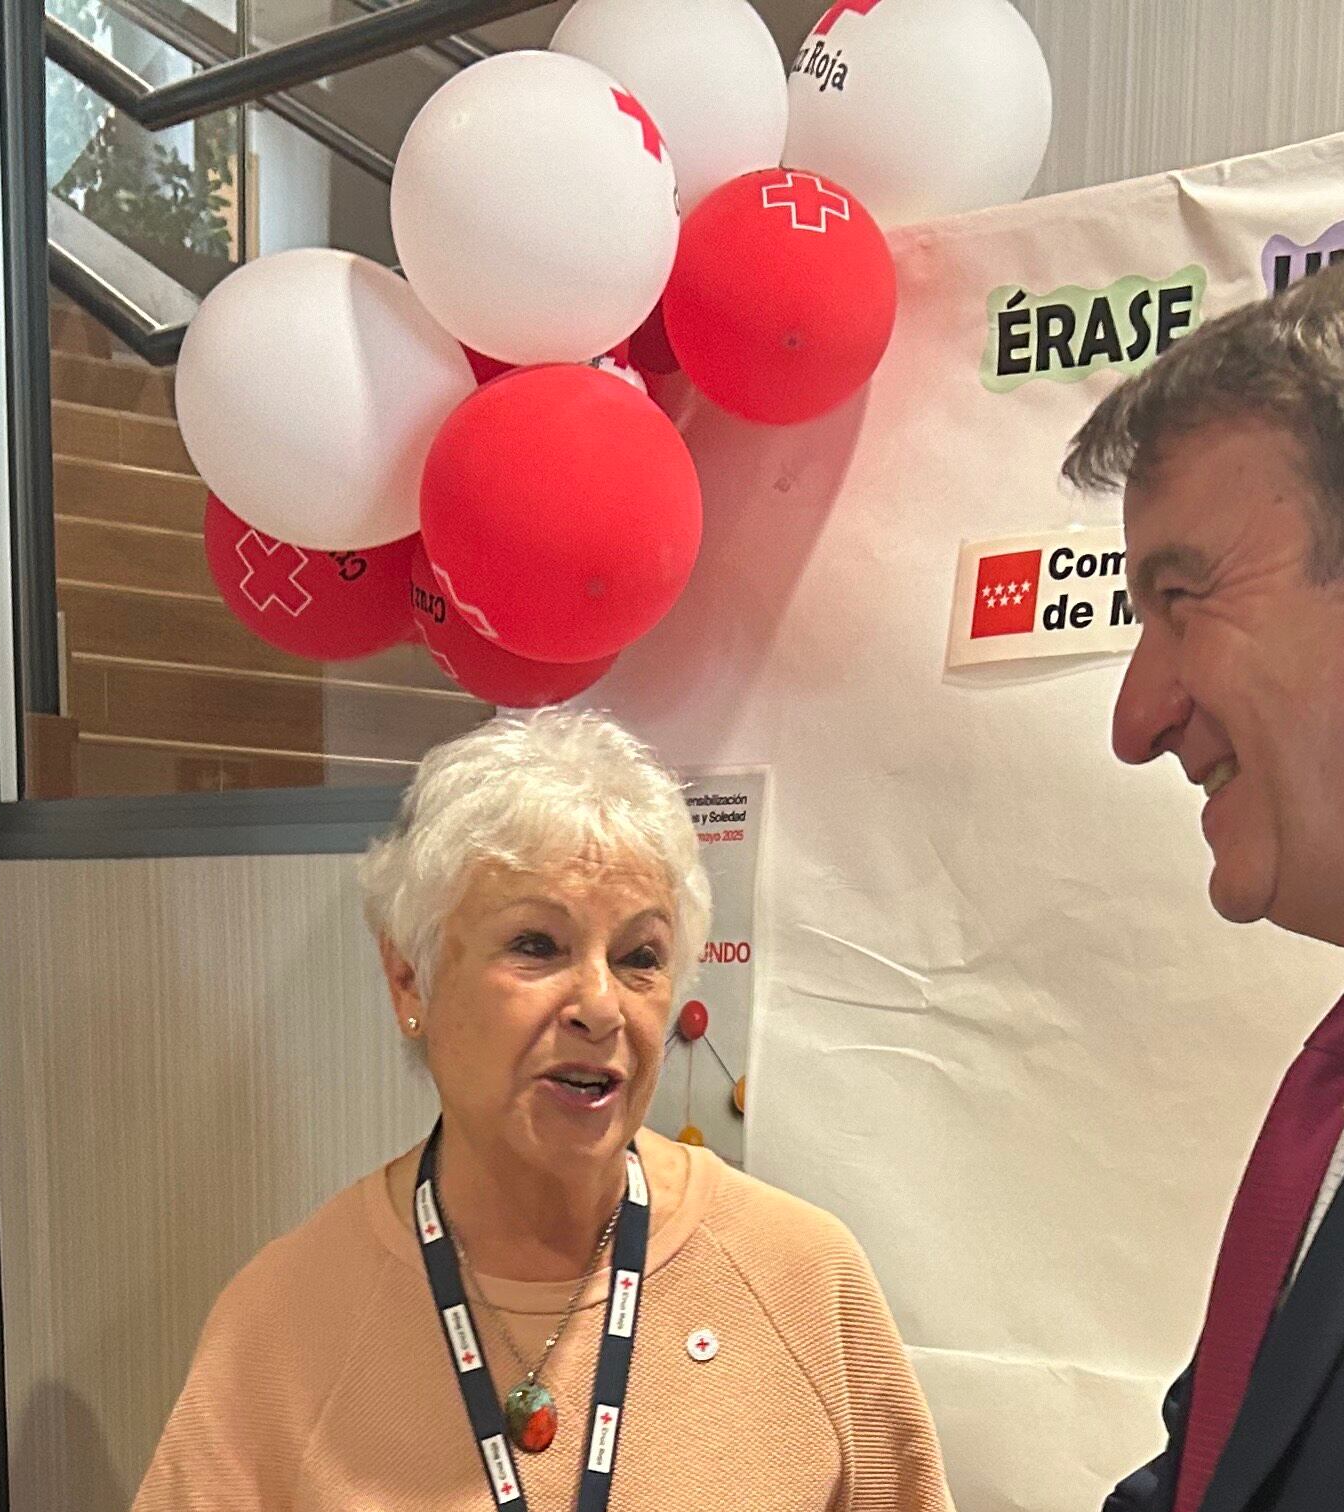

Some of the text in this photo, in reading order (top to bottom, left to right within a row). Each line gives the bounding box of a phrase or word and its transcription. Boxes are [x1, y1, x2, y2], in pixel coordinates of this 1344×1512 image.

[803, 40, 848, 92] Roja
[997, 288, 1193, 376] ÉRASE
[1047, 546, 1127, 581] Com
[1042, 593, 1094, 631] de
[686, 792, 748, 807] ensibilización
[709, 810, 747, 823] Soledad
[722, 829, 744, 842] 2025
[697, 941, 752, 964] UNDO
